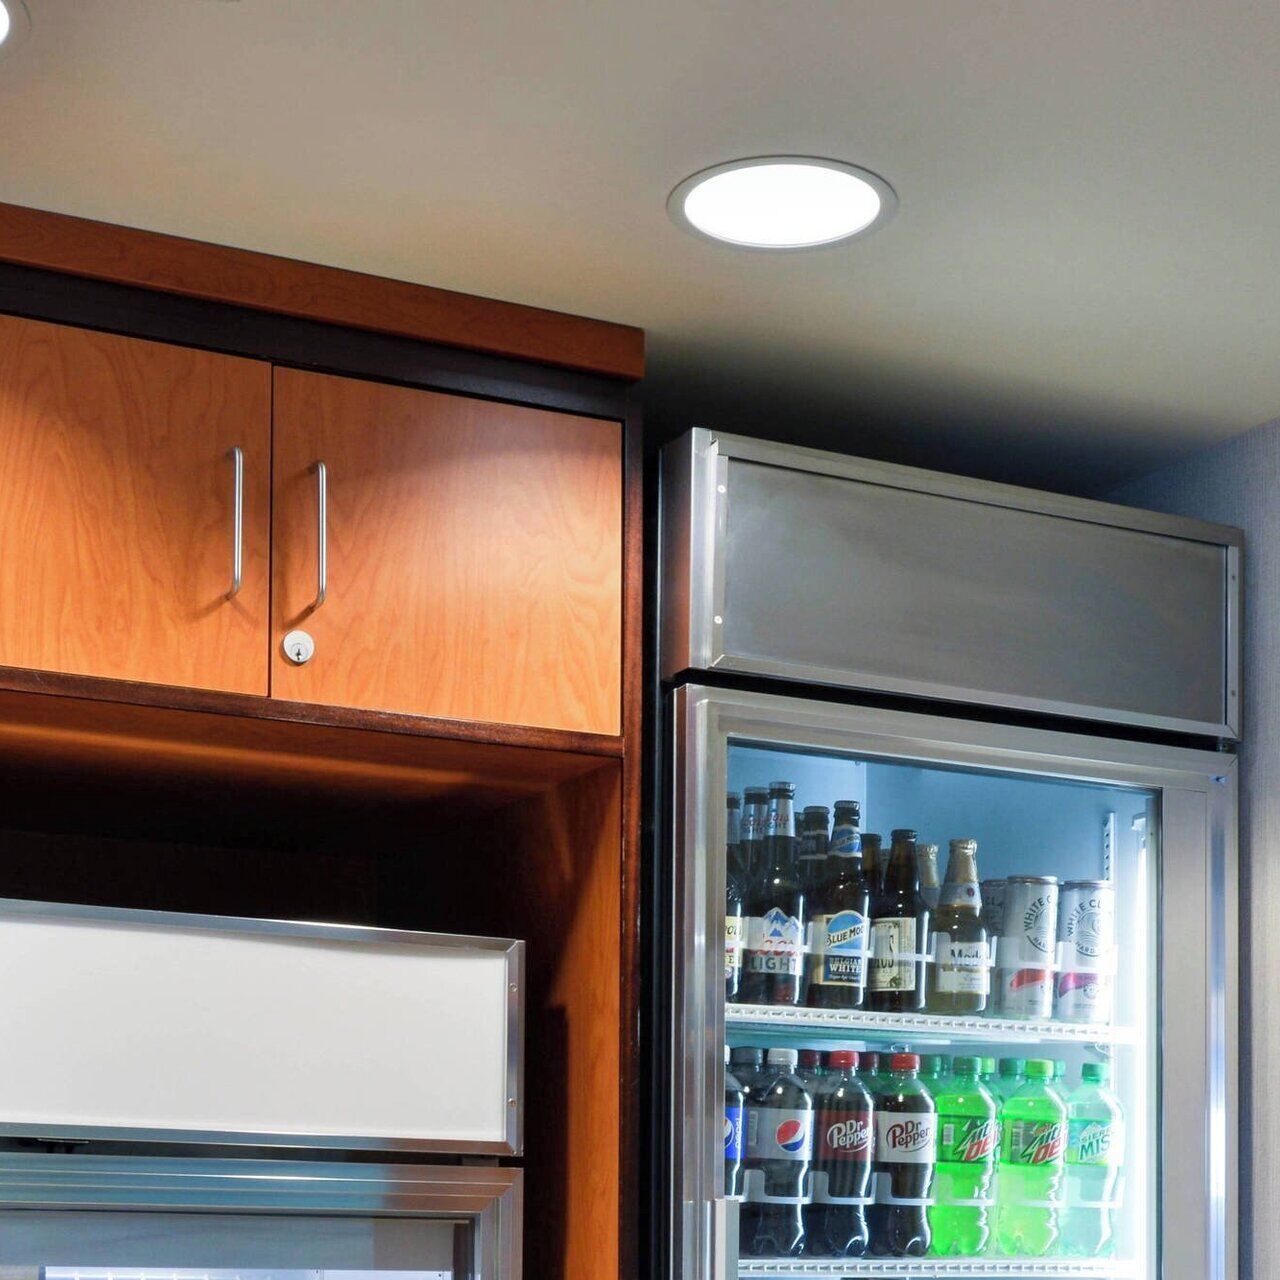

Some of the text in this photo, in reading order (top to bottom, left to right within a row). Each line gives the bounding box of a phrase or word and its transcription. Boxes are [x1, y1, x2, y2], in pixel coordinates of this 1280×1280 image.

[1024, 897, 1044, 932] WHITE
[751, 957, 796, 970] LIGHT
[846, 1120, 864, 1134] Dr
[905, 1120, 922, 1134] Dr
[892, 1124, 931, 1149] Pepper
